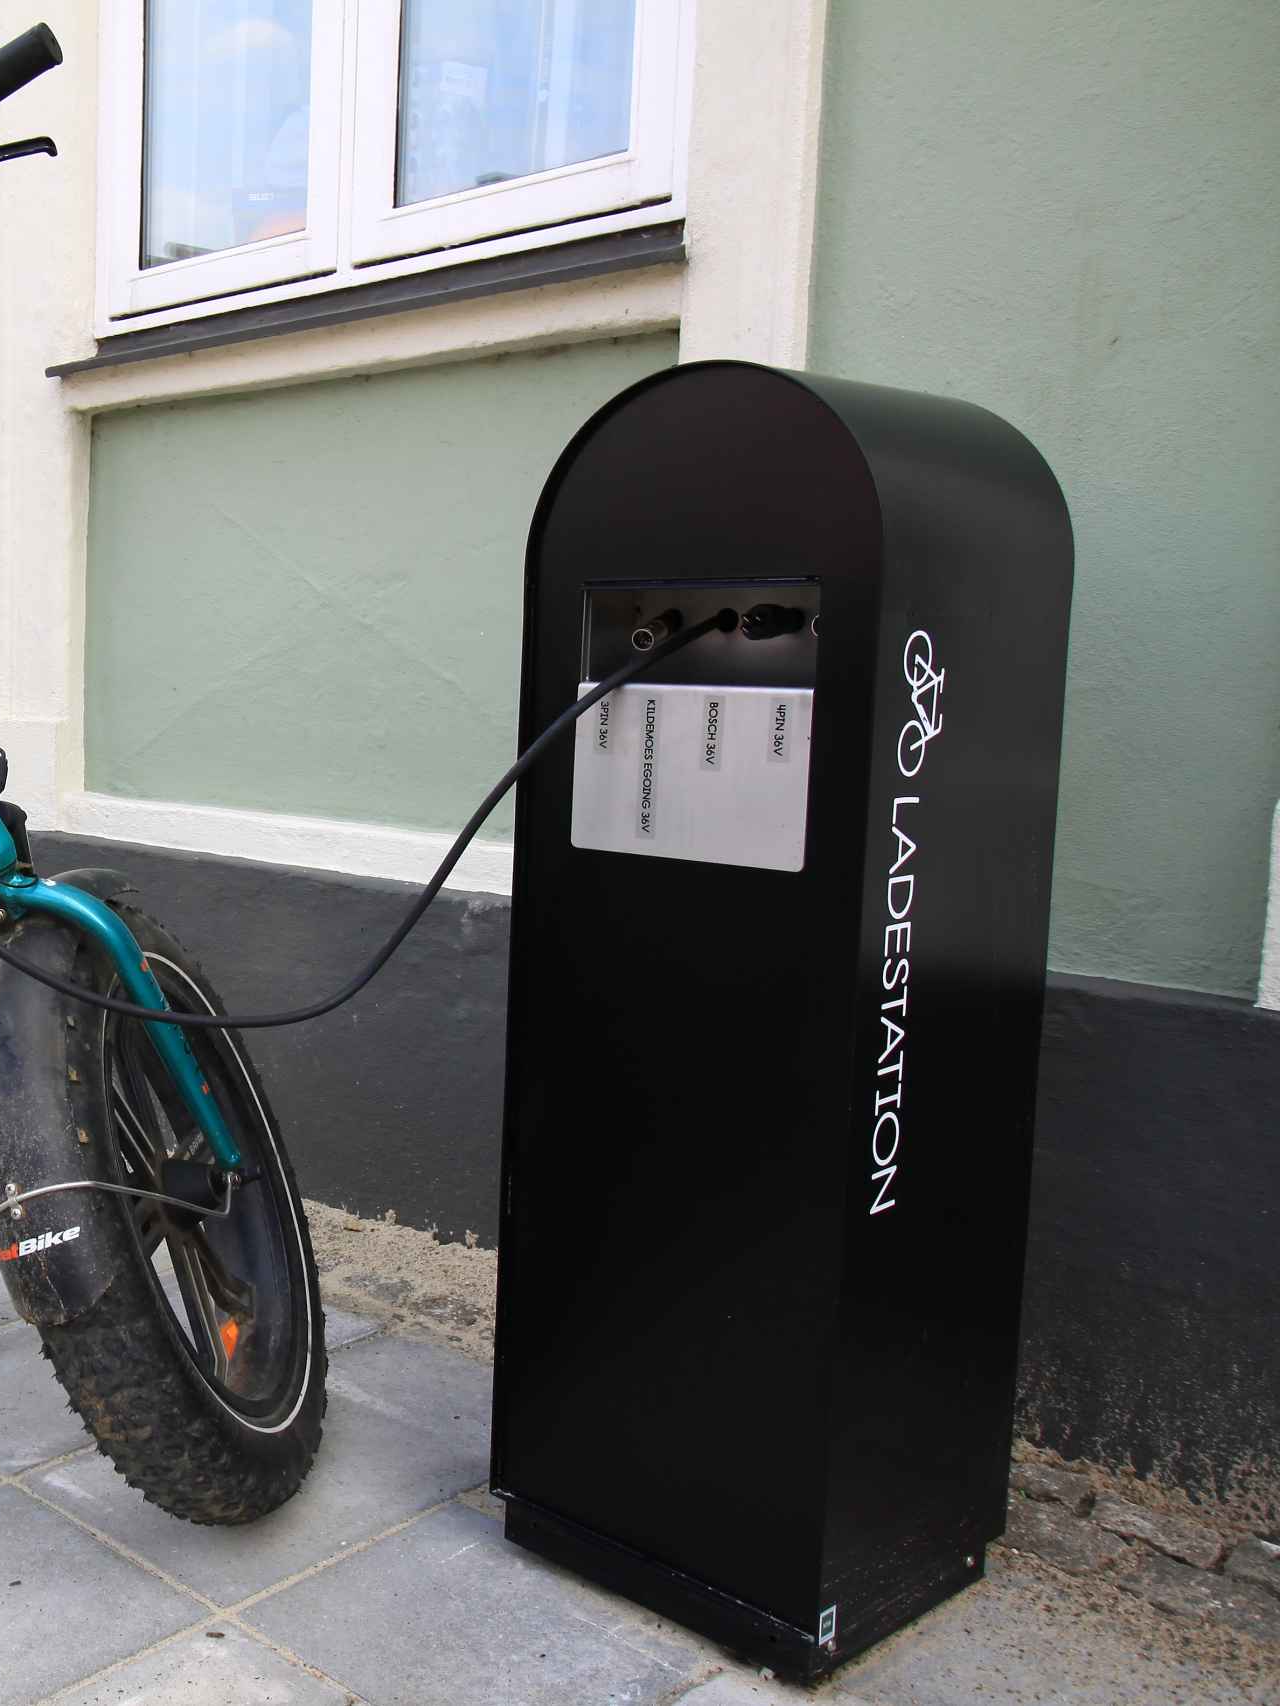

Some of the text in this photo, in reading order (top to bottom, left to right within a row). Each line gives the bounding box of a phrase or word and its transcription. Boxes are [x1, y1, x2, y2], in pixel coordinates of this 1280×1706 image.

[599, 701, 609, 749] 3PIN 36V
[705, 702, 719, 765] BOSCH 36V
[773, 704, 787, 757] 4PIN 36V
[641, 699, 656, 833] KILDEMOES EGOING 36V
[869, 796, 920, 1216] LADESTATION
